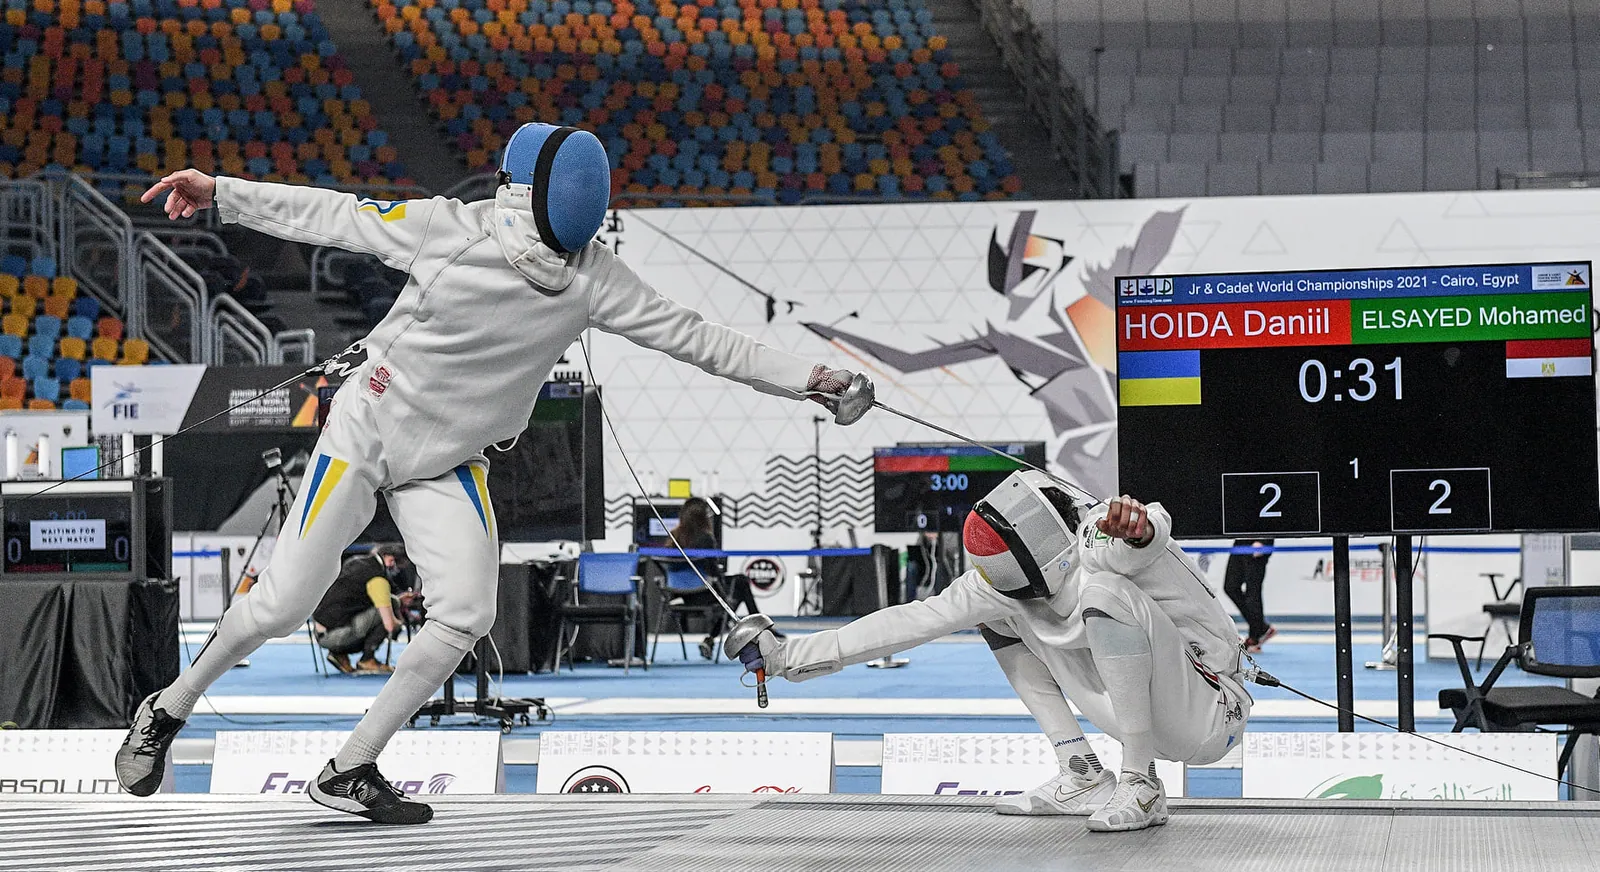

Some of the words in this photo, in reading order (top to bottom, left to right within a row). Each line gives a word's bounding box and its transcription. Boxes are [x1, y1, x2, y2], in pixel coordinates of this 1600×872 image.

[1188, 283, 1201, 295] Jr
[1203, 282, 1213, 295] &
[1216, 281, 1254, 294] Cadet
[1256, 280, 1293, 293] World
[1297, 277, 1394, 293] Championships
[1396, 275, 1427, 289] 2021
[1440, 274, 1479, 287] Cairo,
[1482, 272, 1519, 288] Egypt
[1125, 311, 1234, 340] HOIDA
[1244, 307, 1330, 337] Daniil
[1362, 308, 1472, 330] ELSAYED
[1479, 304, 1586, 326] Mohamed
[1299, 356, 1403, 403] 0:31
[112, 403, 139, 420] FIE
[1349, 457, 1359, 479] 1
[930, 474, 969, 491] 3:00
[1259, 482, 1282, 518] 2
[1428, 479, 1452, 514] 2
[80, 527, 97, 535] FOR
[916, 514, 928, 529] 0
[7, 537, 22, 563] 0
[114, 536, 129, 561] 0
